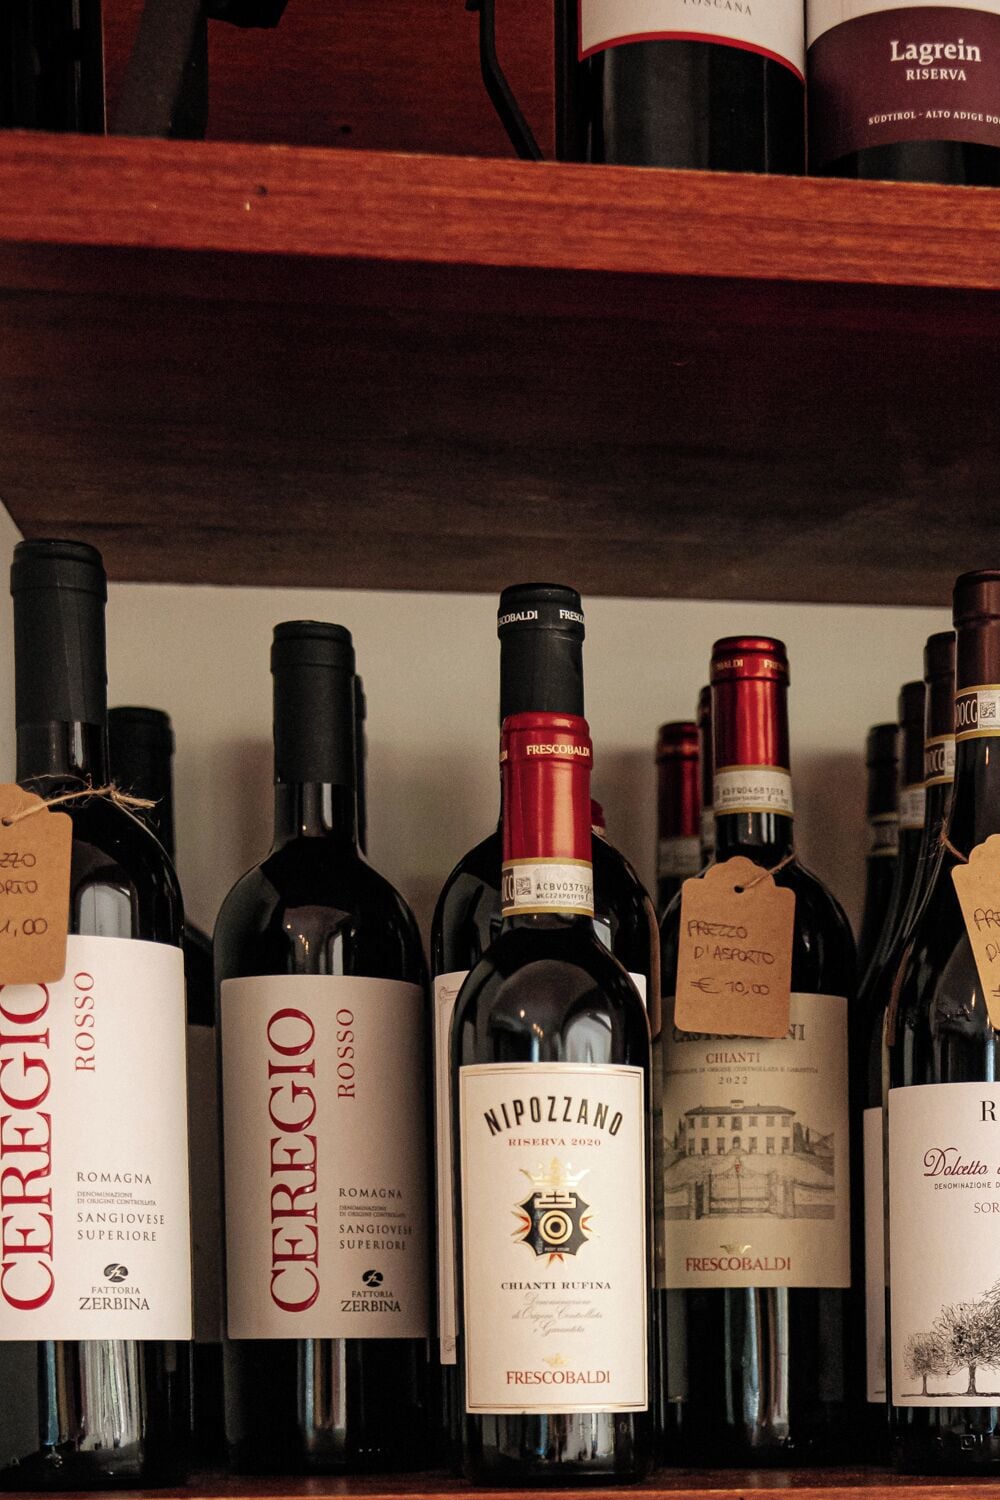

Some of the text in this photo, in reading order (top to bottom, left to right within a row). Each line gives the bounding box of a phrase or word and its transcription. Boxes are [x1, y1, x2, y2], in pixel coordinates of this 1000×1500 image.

[890, 38, 982, 65] Lagrein
[906, 68, 967, 81] RISERVA
[868, 111, 916, 125] SÜDTIROL
[925, 110, 951, 119] ALTO
[953, 111, 984, 122] ADIGE
[526, 744, 590, 757] FRESCOBALDI
[688, 920, 748, 939] PREZZO
[690, 977, 720, 994] €
[74, 971, 95, 1072] ROSSO
[336, 1008, 355, 1099] ROSSO
[705, 1052, 761, 1064] CHIANTI
[483, 1095, 625, 1137] NIPOZZANO
[508, 1138, 602, 1147] RISERVA 2020
[267, 1007, 320, 1313] CEREGIO
[923, 1147, 988, 1177] Dolcetto
[76, 1171, 152, 1185] ROMAGNA
[934, 1181, 992, 1190] DENOMINAZIONE
[339, 1187, 402, 1200] ROMAGNA
[77, 1212, 165, 1226] SANGIOVESE
[77, 1229, 157, 1242] SUPERIORE
[339, 1223, 413, 1236] SANGIOVESE
[339, 1239, 408, 1251] SUPERIORE
[686, 1257, 791, 1271] FRESCOBALDI
[91, 1286, 141, 1295] FATTORIA
[501, 1282, 612, 1290] CHIANTI RUFINA
[351, 1290, 394, 1298] FATTORIA
[79, 1297, 150, 1311] ZERBINA
[341, 1300, 402, 1313] ZERBINA
[506, 1370, 611, 1386] FRESCOBALDI
